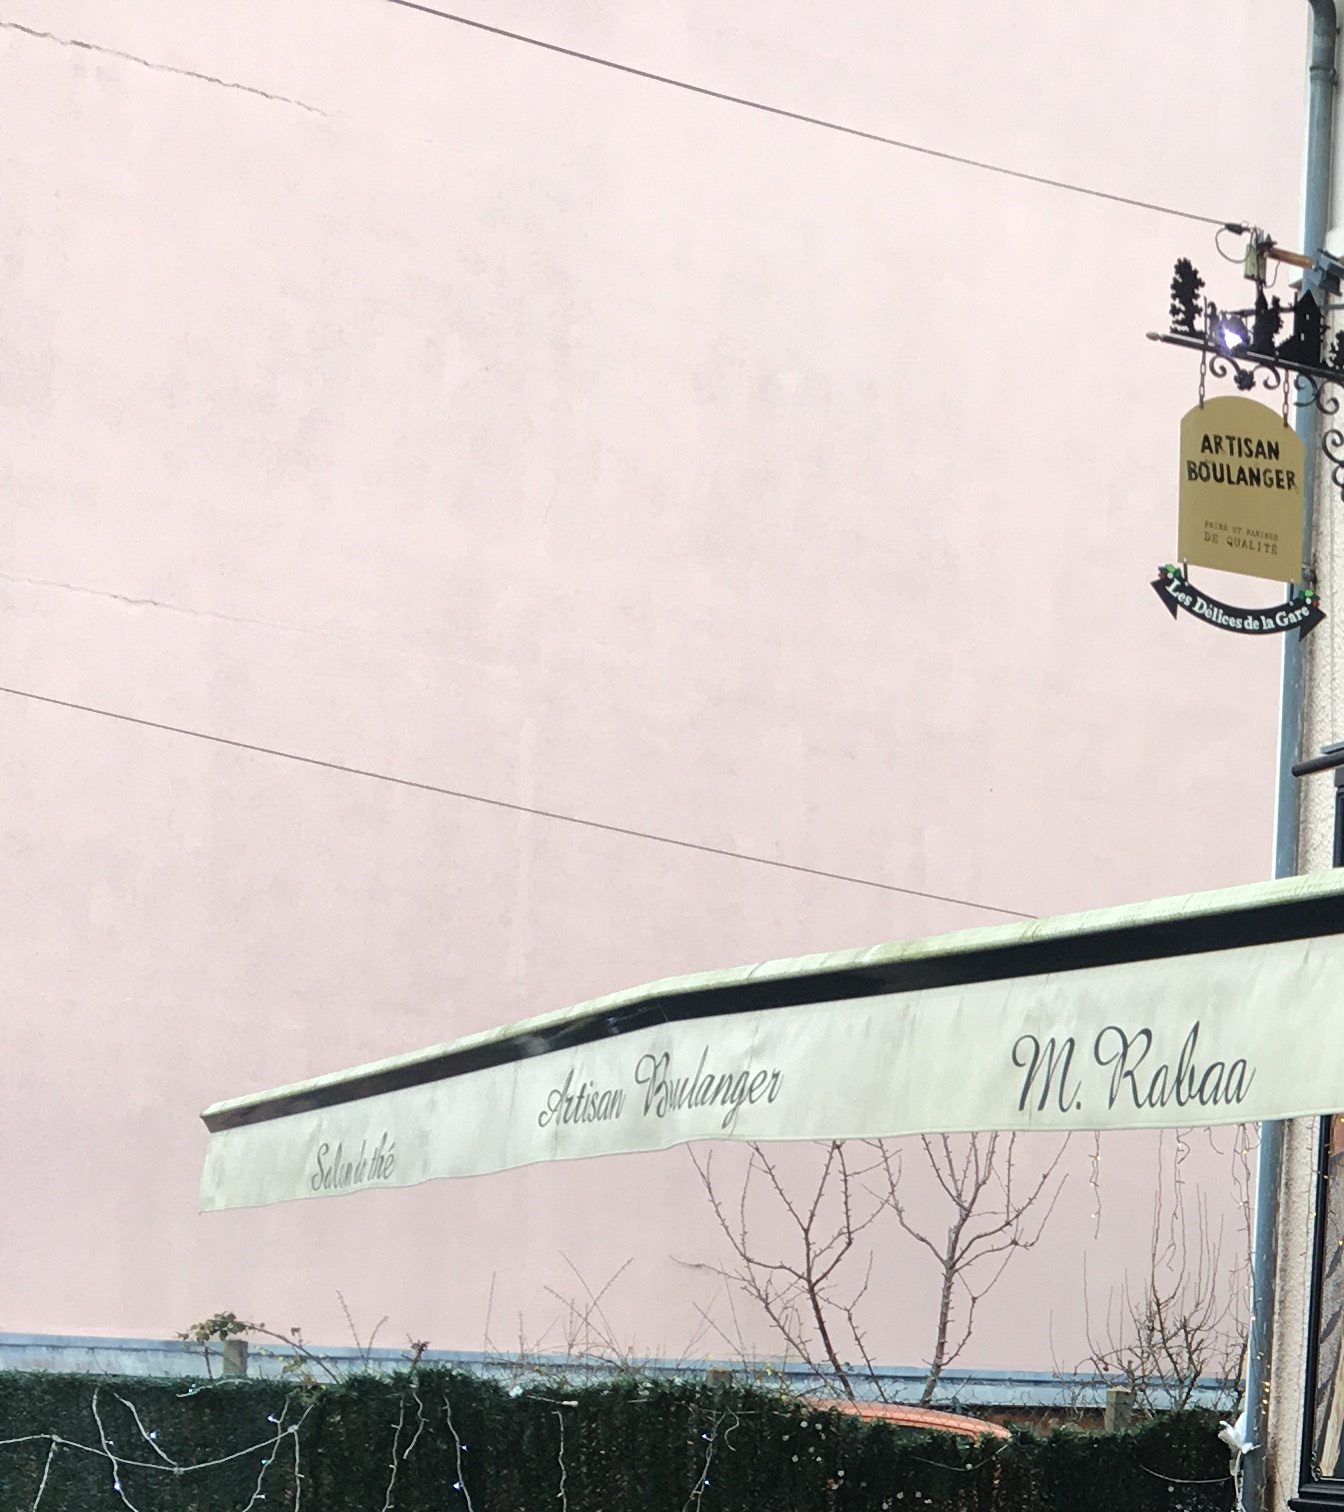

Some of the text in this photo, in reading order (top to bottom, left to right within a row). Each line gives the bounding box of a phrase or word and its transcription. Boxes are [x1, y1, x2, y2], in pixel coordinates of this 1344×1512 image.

[1200, 433, 1280, 461] ARTISAN
[1186, 460, 1299, 493] BOULANGER
[1203, 531, 1278, 555] DE QUALITÉ
[1232, 526, 1242, 535] ET
[1165, 577, 1310, 630] Les Délices de la Gare
[1011, 1020, 1256, 1113] M. Rabaa
[537, 1067, 625, 1128] Artisan
[367, 1131, 396, 1181] thé
